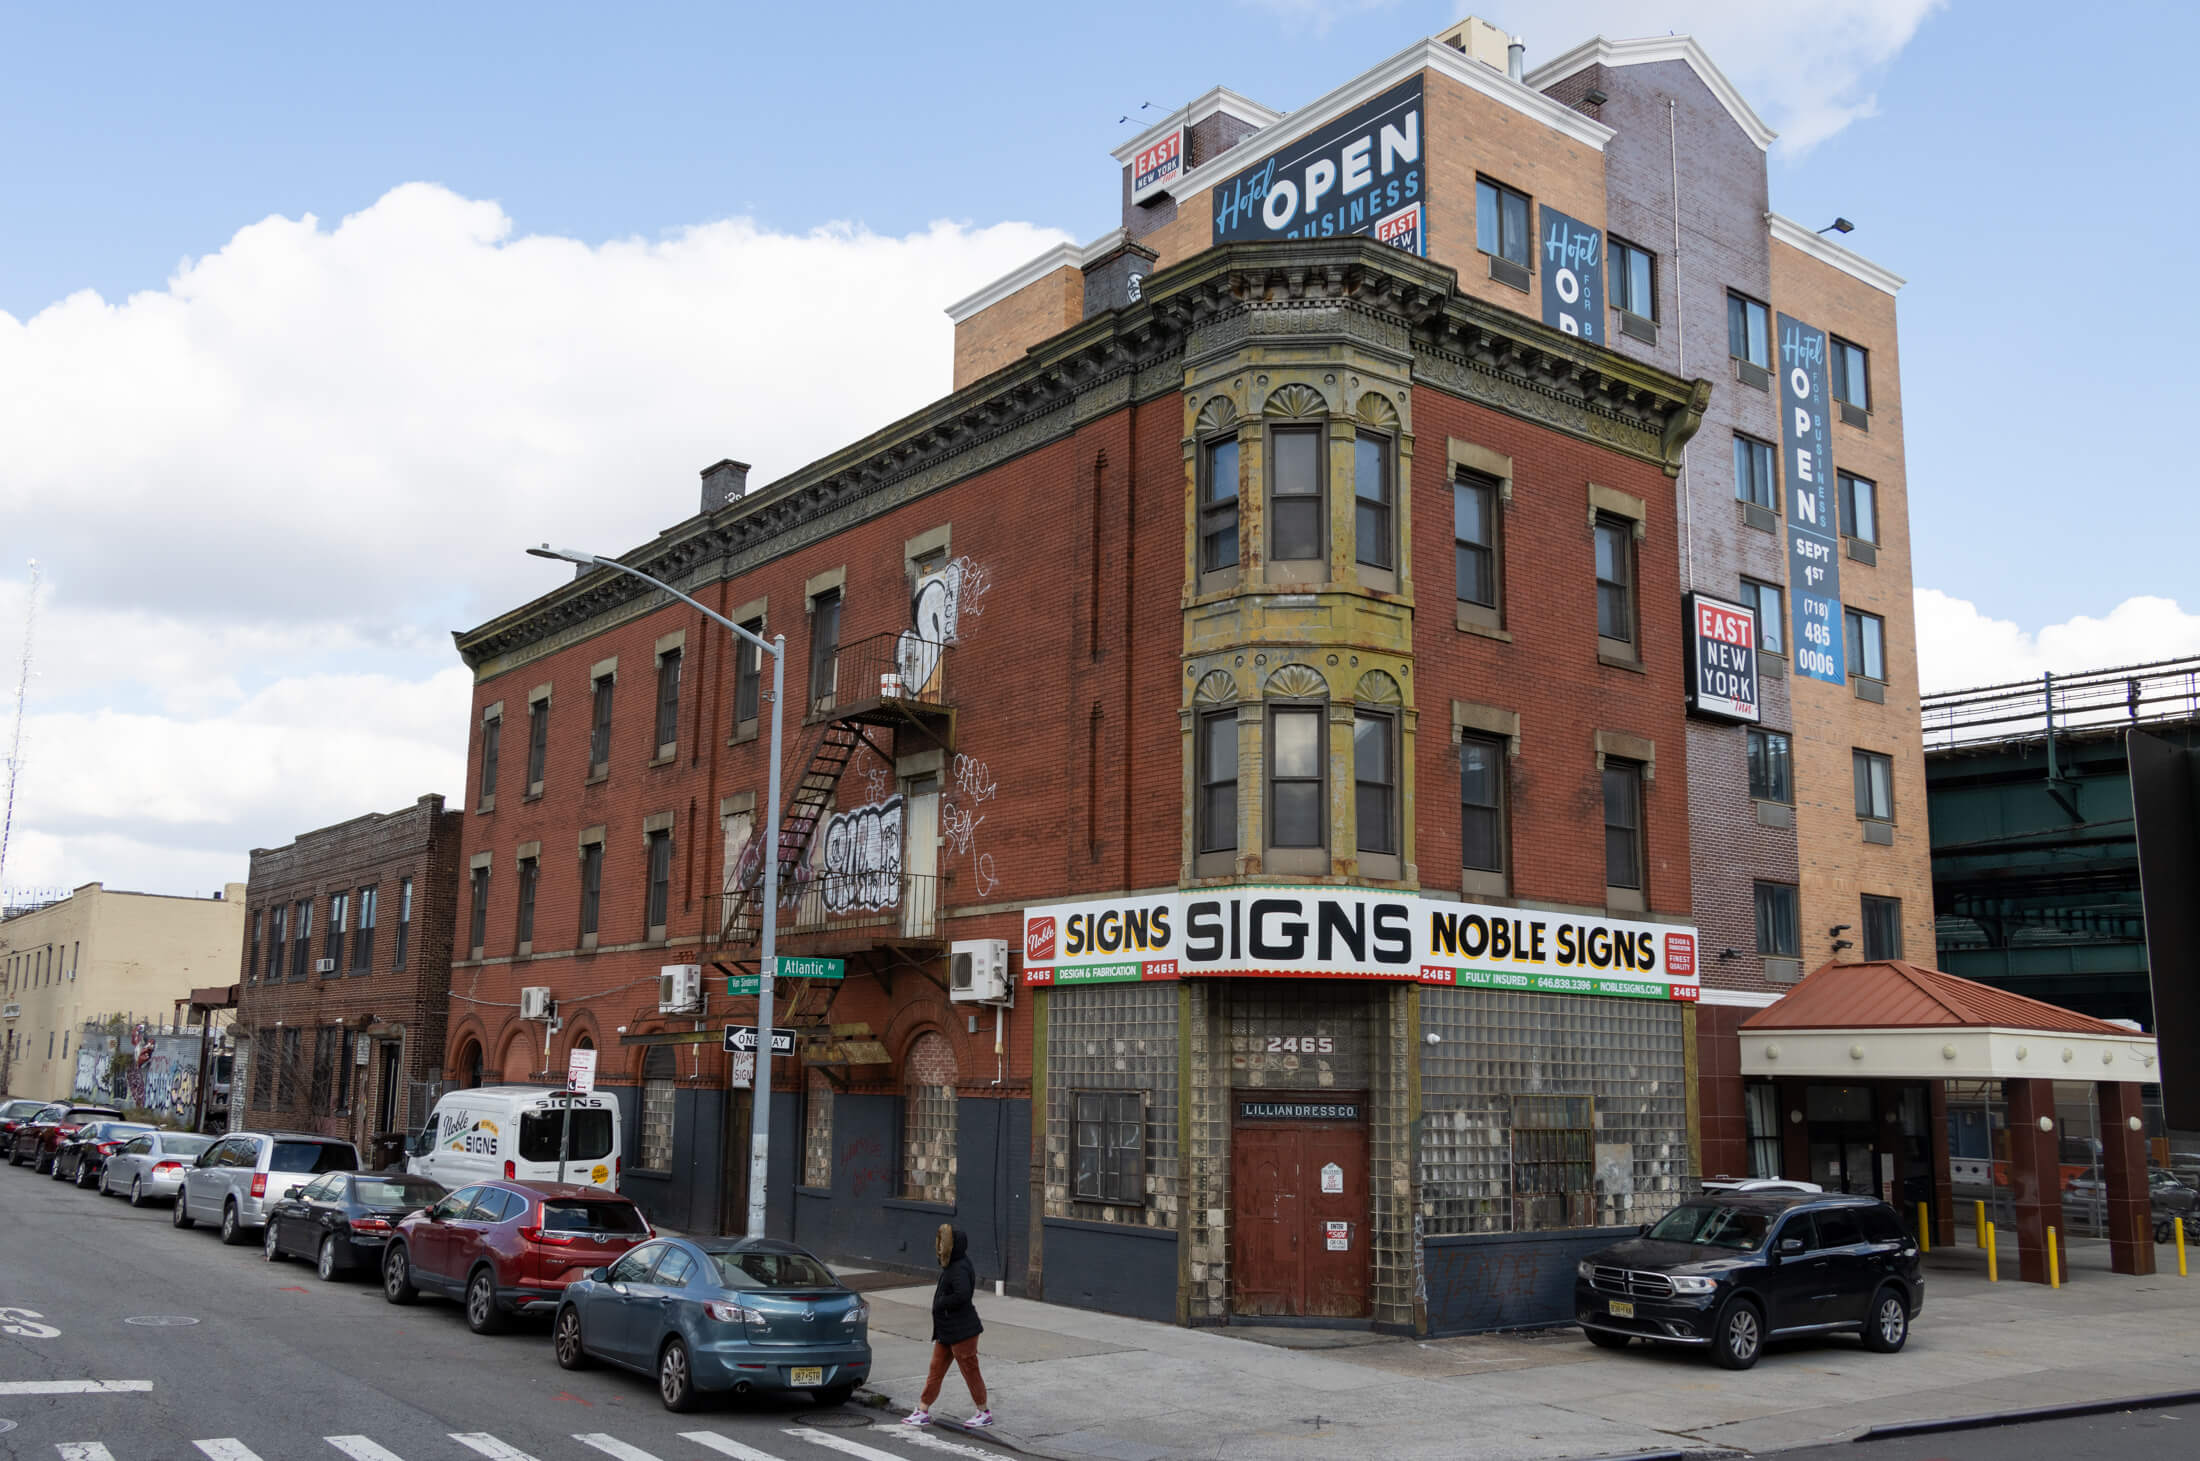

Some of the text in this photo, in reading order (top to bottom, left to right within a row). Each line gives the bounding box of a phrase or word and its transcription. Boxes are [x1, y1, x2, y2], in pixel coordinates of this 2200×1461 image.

[1138, 137, 1177, 177] EAST
[1263, 110, 1420, 231] OPEN
[1138, 158, 1177, 189] NEW YORK
[1216, 157, 1275, 235] Hotel
[1381, 212, 1416, 242] EAST
[1389, 230, 1413, 249] EW
[1545, 221, 1599, 272] Hotel
[1583, 274, 1592, 312] FOR
[1781, 327, 1824, 370] Hotel
[1812, 371, 1821, 405] FOR
[1790, 366, 1817, 525] OPEN
[1813, 414, 1827, 528] BUSINESS
[1796, 538, 1830, 563] SEPT
[1804, 565, 1825, 587] 1ST
[1803, 598, 1829, 621] (718)
[1701, 608, 1749, 646] EAST
[1804, 621, 1831, 647] 485
[1707, 640, 1747, 673] NEW
[1799, 648, 1834, 676] 0006
[1703, 667, 1751, 701] YORK
[1027, 924, 1055, 952] Noble
[1064, 905, 1172, 957] SIGNS
[1185, 898, 1412, 965] SIGNS
[1430, 911, 1656, 974] NOBLE SIGNS
[784, 960, 824, 975] Atlantic
[1027, 970, 1051, 981] 2465
[1059, 965, 1137, 979] DESIGN & FABRICATION
[1147, 963, 1174, 975] 2465
[1422, 968, 1452, 980] 2465
[1465, 971, 1491, 983] FULLY
[1492, 973, 1528, 986] INSURED
[1599, 981, 1662, 995] NOBLESIGNS.COM
[1673, 986, 1697, 998] 2465
[738, 1034, 785, 1047] ONE AY
[1267, 1036, 1333, 1053] 2465
[443, 1110, 469, 1138] Noble
[1245, 1104, 1293, 1115] LILLIAN
[1295, 1105, 1336, 1117] DRESS
[465, 1135, 497, 1155] SIGNS
